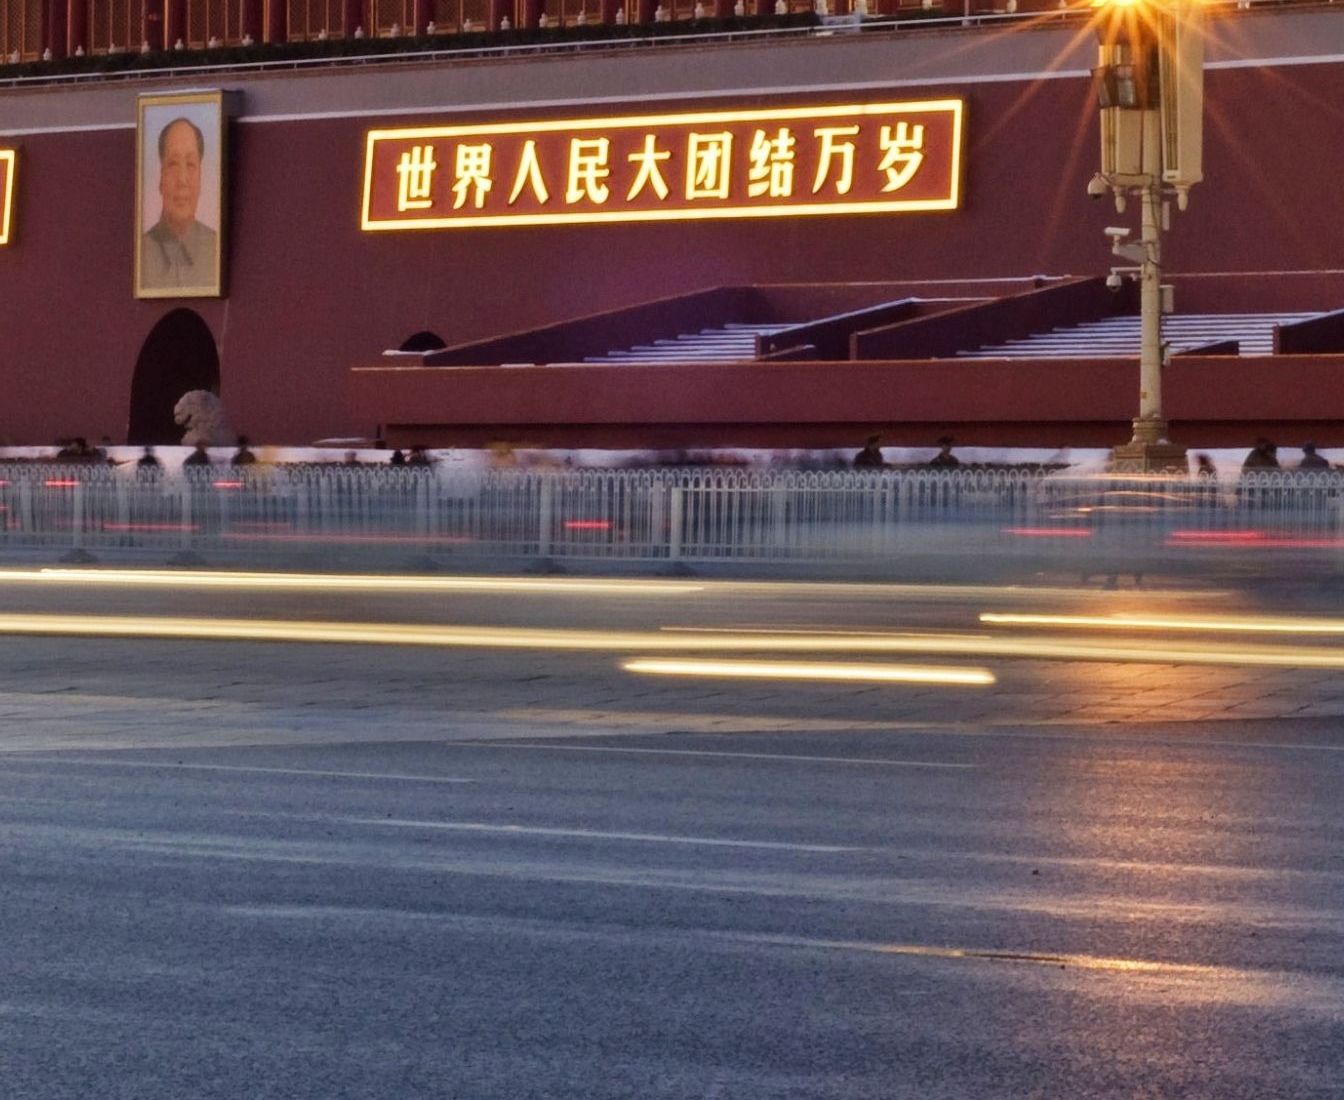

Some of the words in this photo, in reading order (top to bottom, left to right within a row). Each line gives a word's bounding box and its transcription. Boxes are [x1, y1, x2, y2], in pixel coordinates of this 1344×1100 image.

[396, 121, 924, 212] 世界人民大团结万岁
